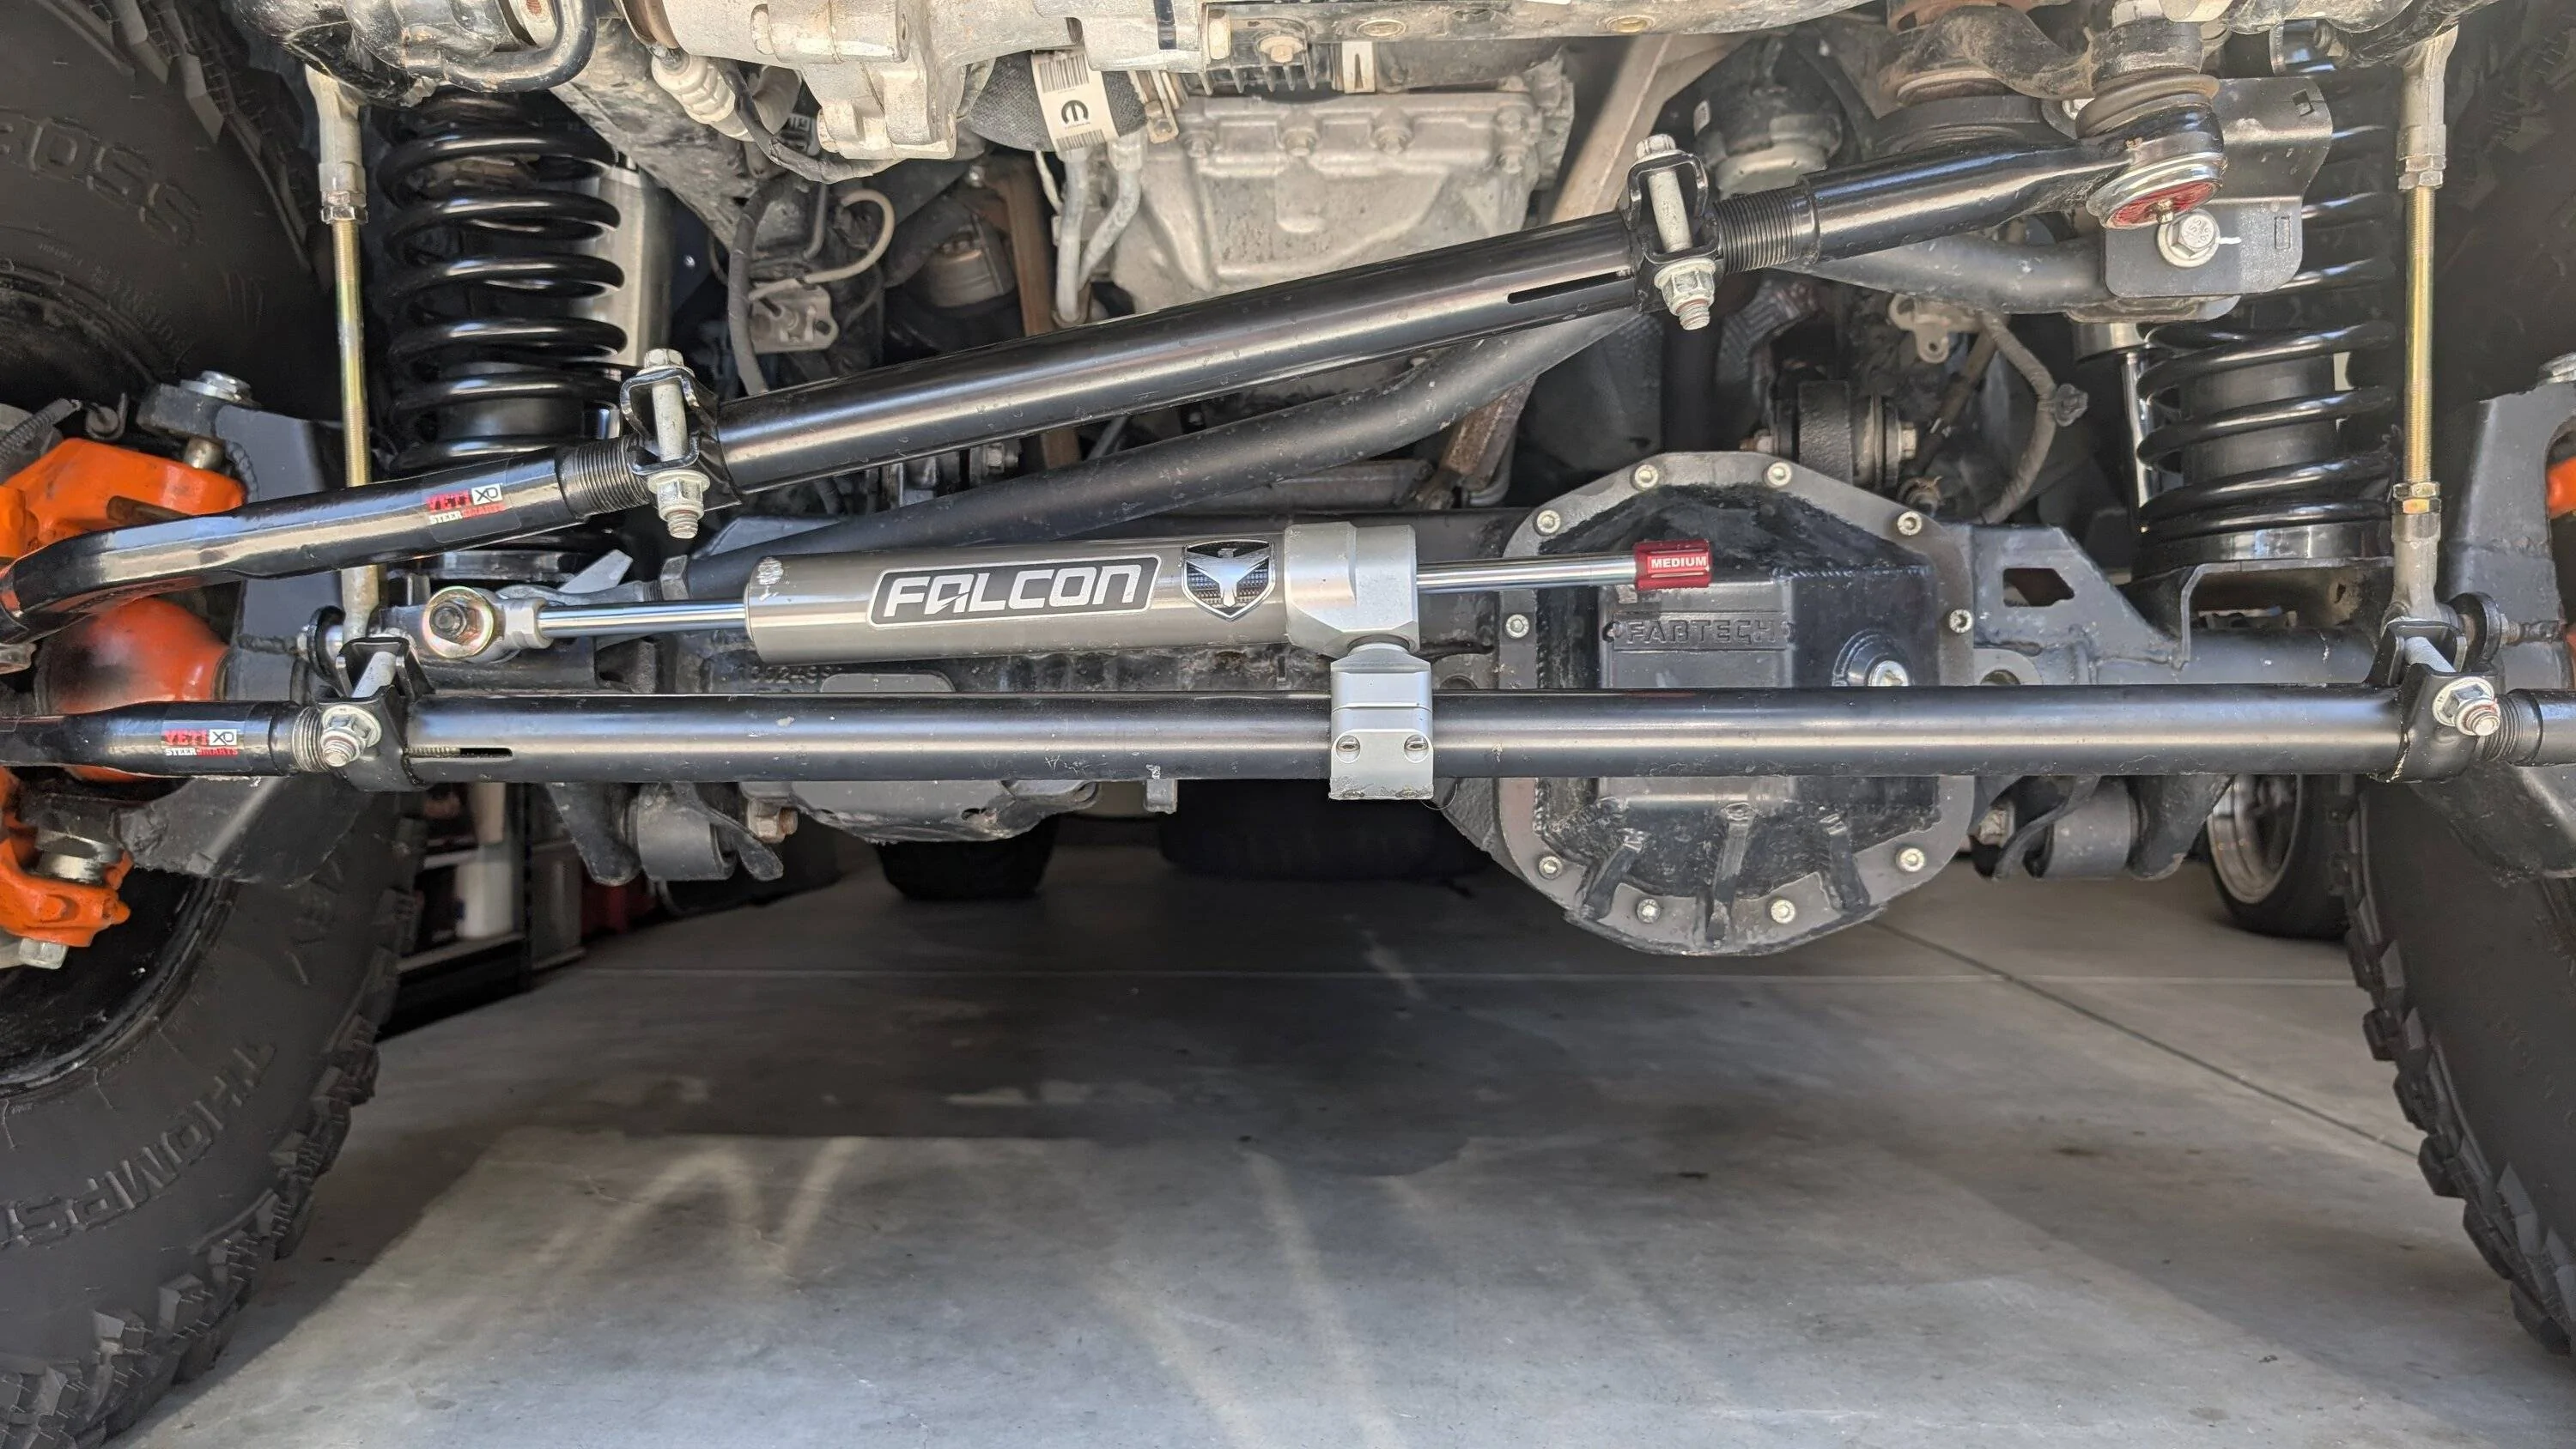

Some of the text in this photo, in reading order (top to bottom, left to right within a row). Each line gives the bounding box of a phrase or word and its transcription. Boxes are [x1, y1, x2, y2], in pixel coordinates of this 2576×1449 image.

[1651, 555, 1707, 568] MEDIUM
[883, 564, 1142, 618] FALCON
[1625, 619, 1777, 644] FABTECH
[165, 729, 208, 745] YETI
